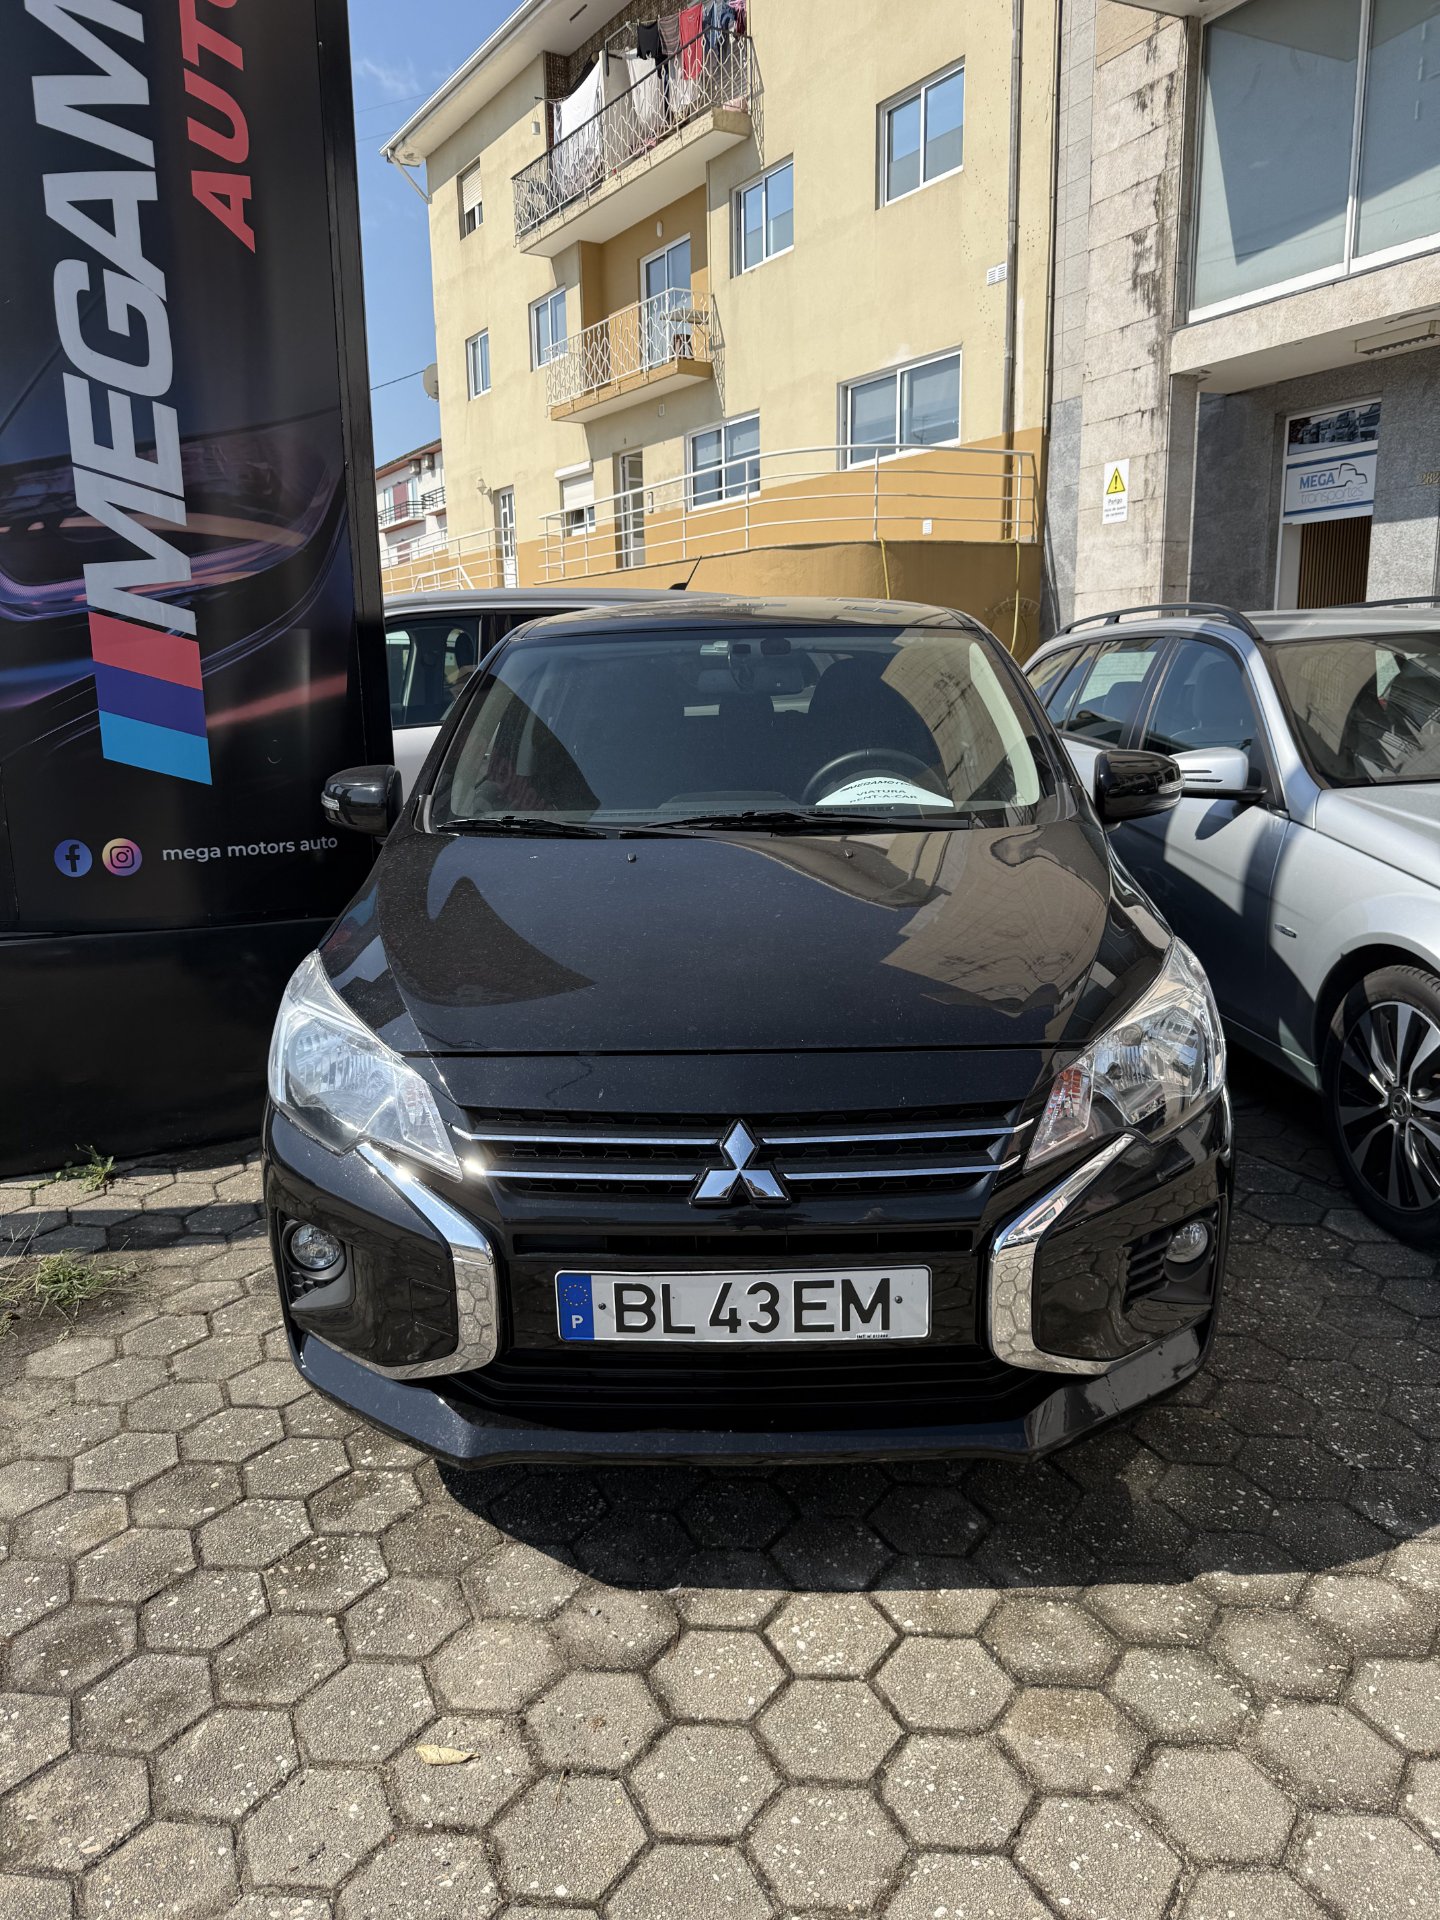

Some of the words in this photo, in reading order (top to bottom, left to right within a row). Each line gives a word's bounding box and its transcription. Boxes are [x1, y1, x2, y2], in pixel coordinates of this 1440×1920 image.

[179, 0, 256, 254] AUT
[1299, 472, 1335, 490] MEGA
[856, 789, 907, 797] VIATURA
[162, 845, 221, 862] mega
[227, 840, 296, 857] motors
[299, 836, 338, 851] auto
[613, 1281, 696, 1334] BL
[571, 1315, 584, 1329] P
